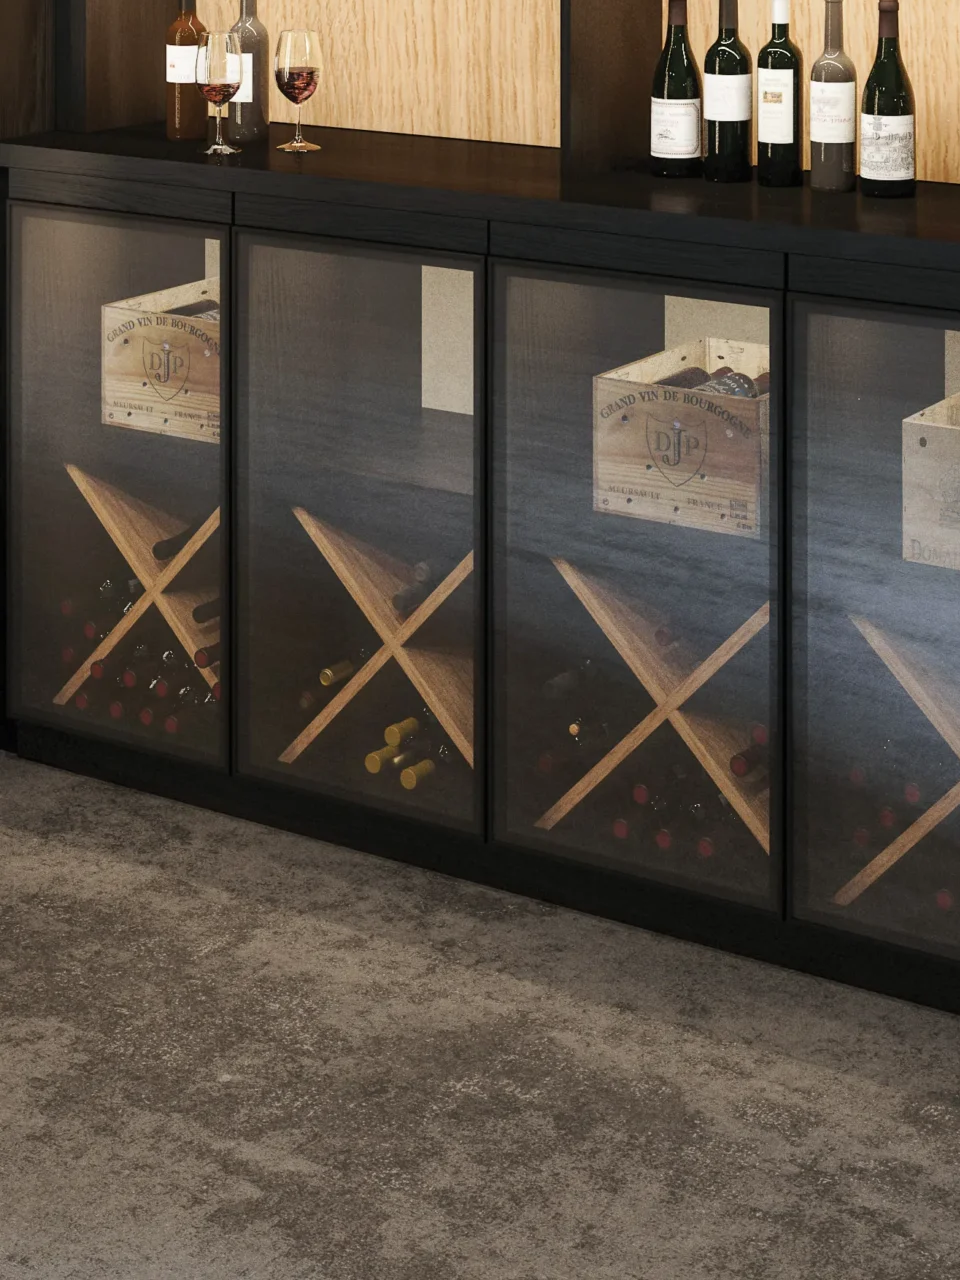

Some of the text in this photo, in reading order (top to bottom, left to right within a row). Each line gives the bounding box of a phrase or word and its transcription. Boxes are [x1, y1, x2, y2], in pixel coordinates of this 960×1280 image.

[106, 316, 220, 356] GRAND VIN DE BOURGOGN
[600, 390, 751, 440] GRAND VIN DE BOURGOGNE
